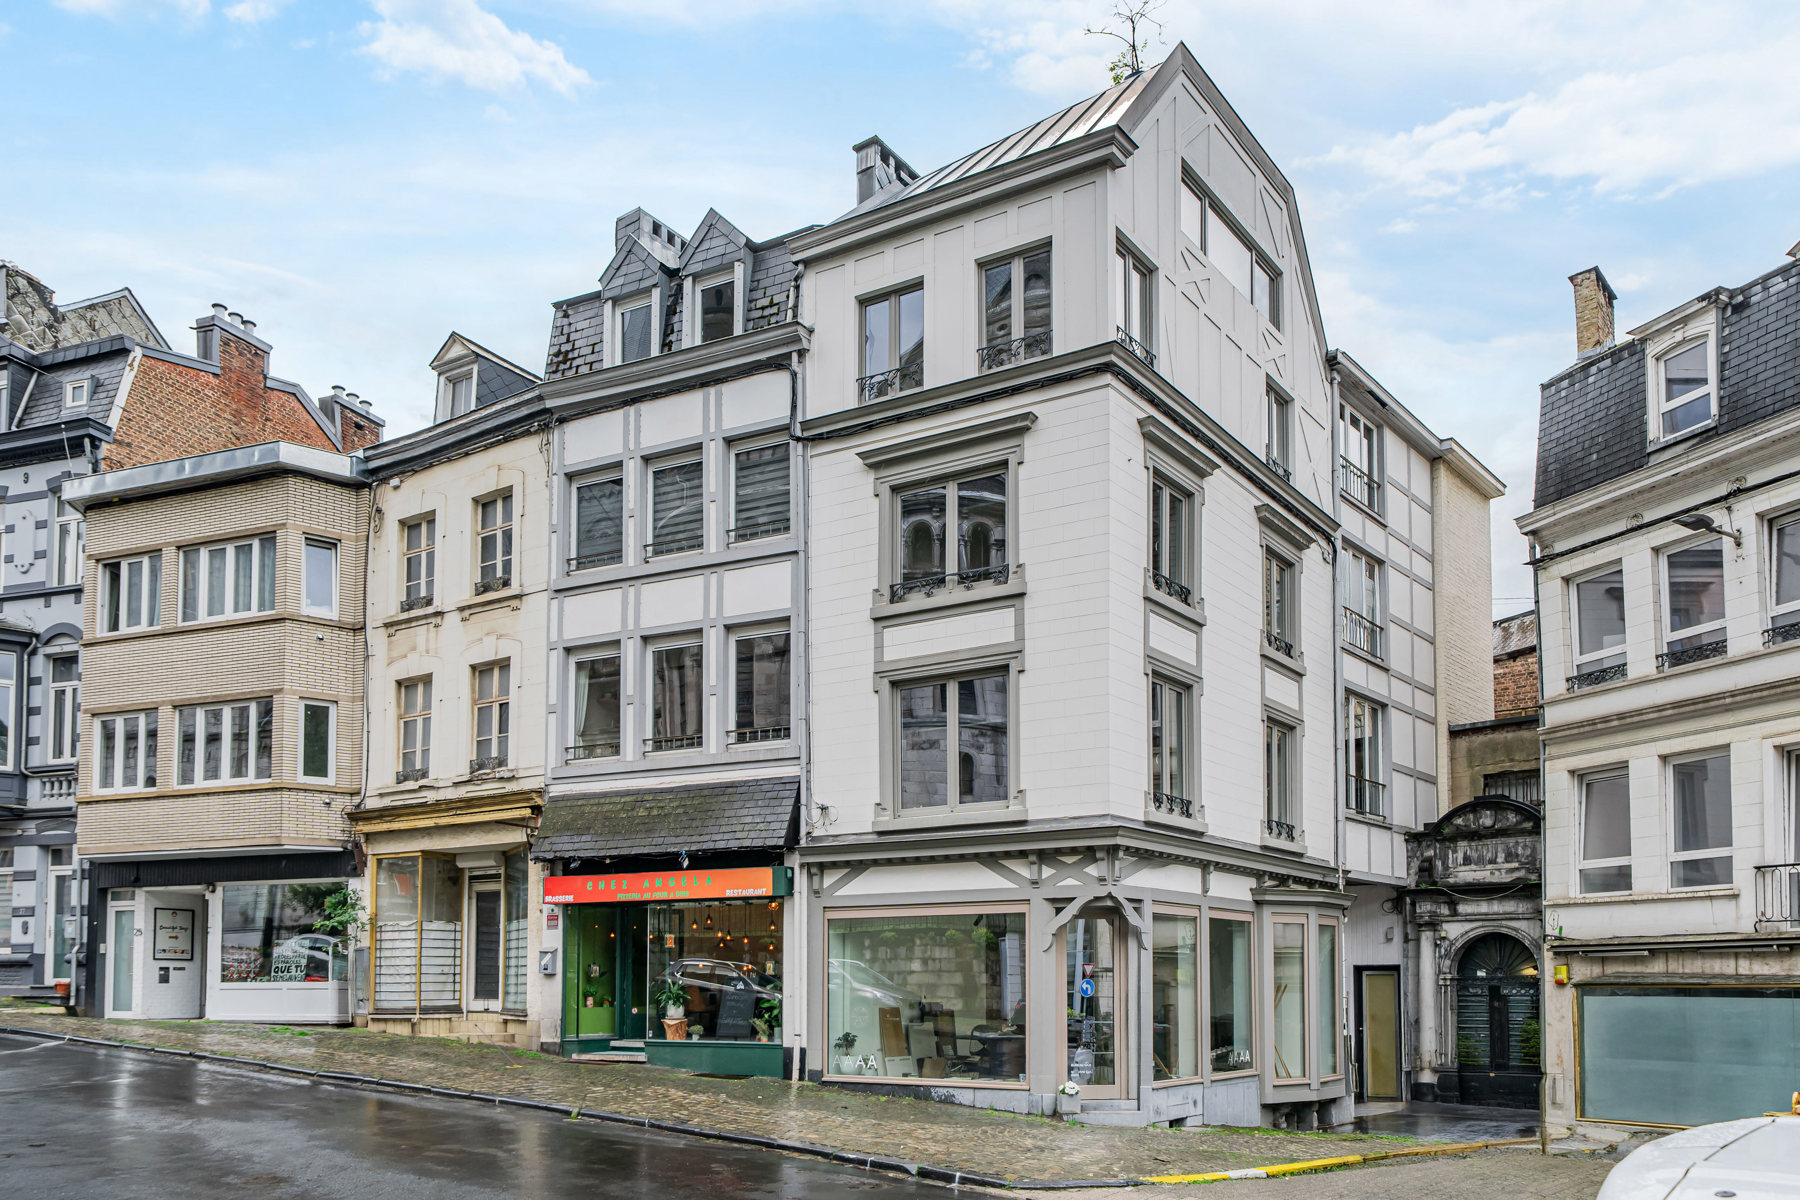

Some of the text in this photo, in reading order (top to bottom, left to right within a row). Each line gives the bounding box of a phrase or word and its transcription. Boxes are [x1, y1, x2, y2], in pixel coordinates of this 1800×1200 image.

[587, 876, 712, 890] CHEZ ANGELA
[617, 891, 641, 900] PIZZERIA
[676, 890, 690, 898] BOIS
[726, 888, 767, 896] RESTAURANT
[273, 965, 307, 974] QUE TU
